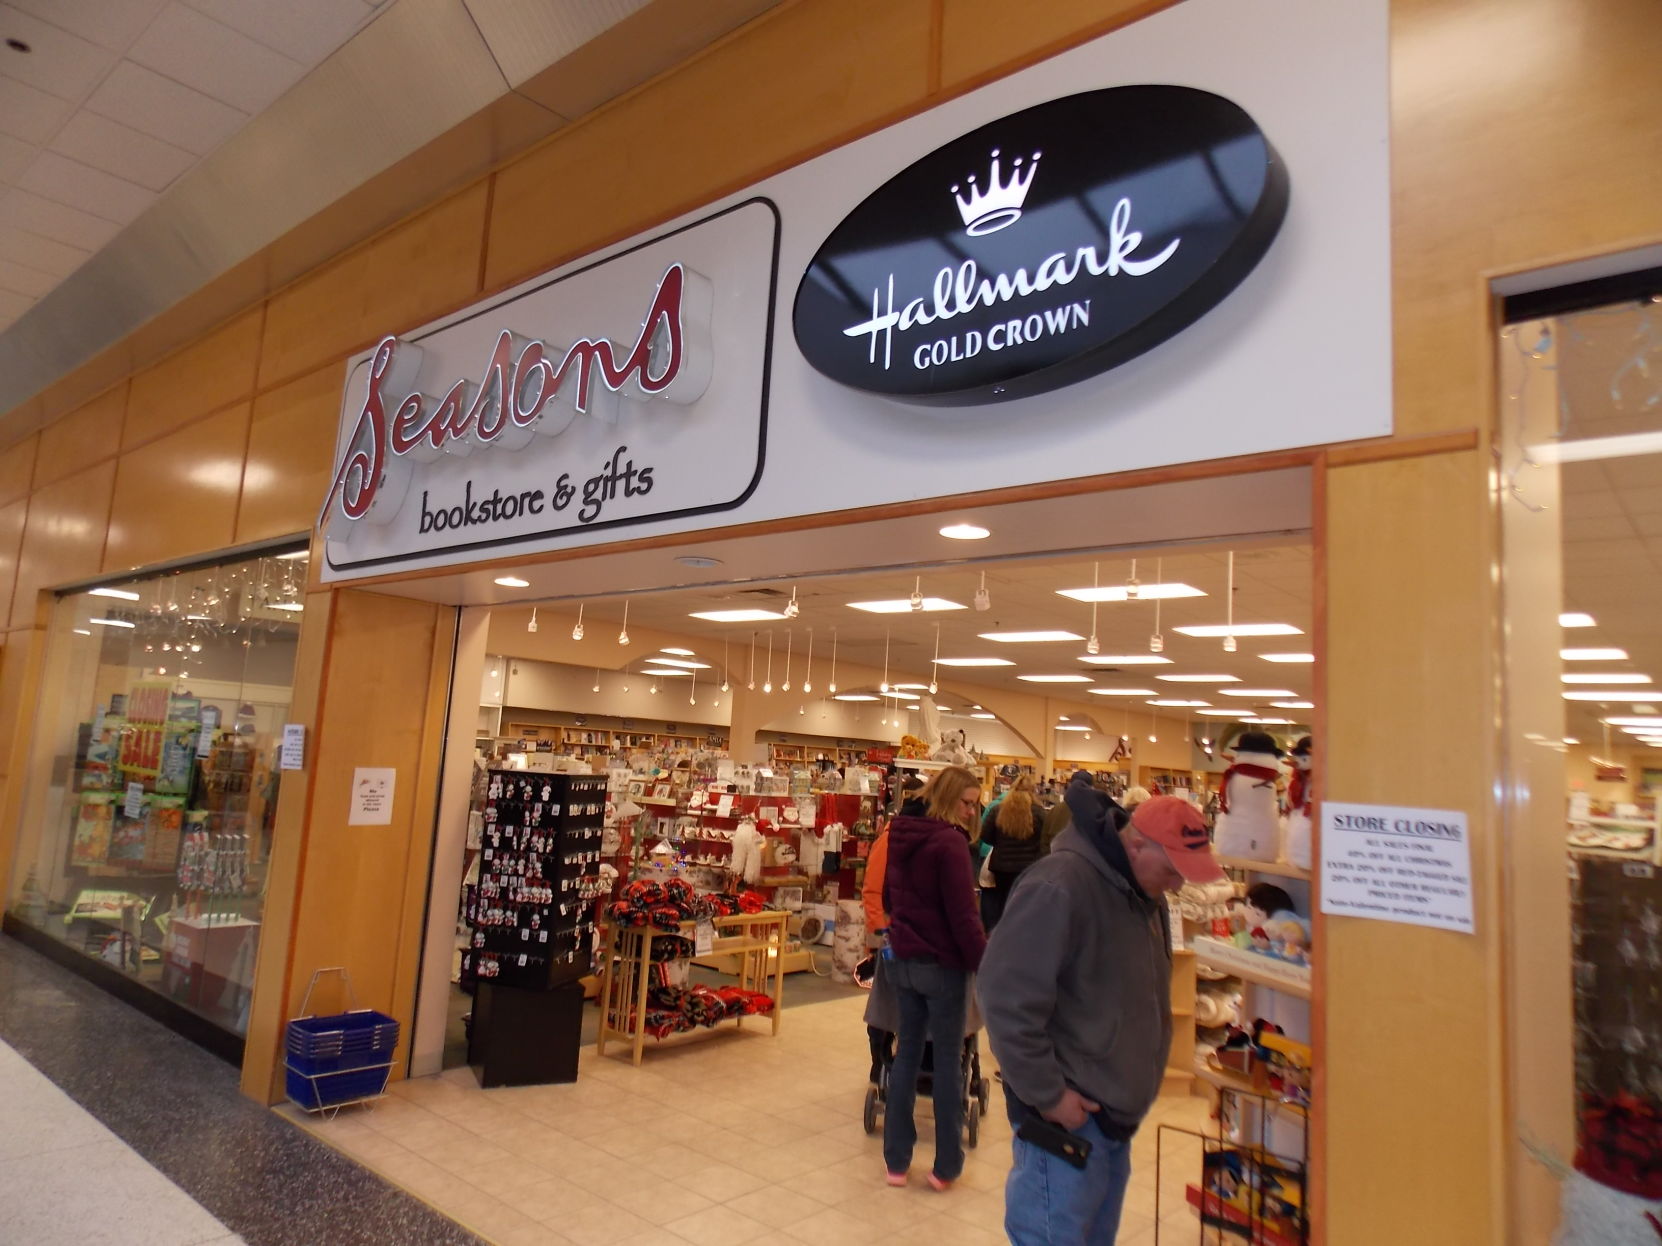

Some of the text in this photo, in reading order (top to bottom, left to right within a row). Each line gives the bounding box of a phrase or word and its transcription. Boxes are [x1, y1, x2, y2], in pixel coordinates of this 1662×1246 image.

[844, 197, 1181, 370] Hallmark
[913, 300, 1091, 370] GOLD CROWN
[317, 261, 685, 531] Seasons
[419, 445, 654, 534] bookstore & gifts
[122, 732, 162, 770] SALE
[1333, 814, 1462, 838] STORE CLOSING
